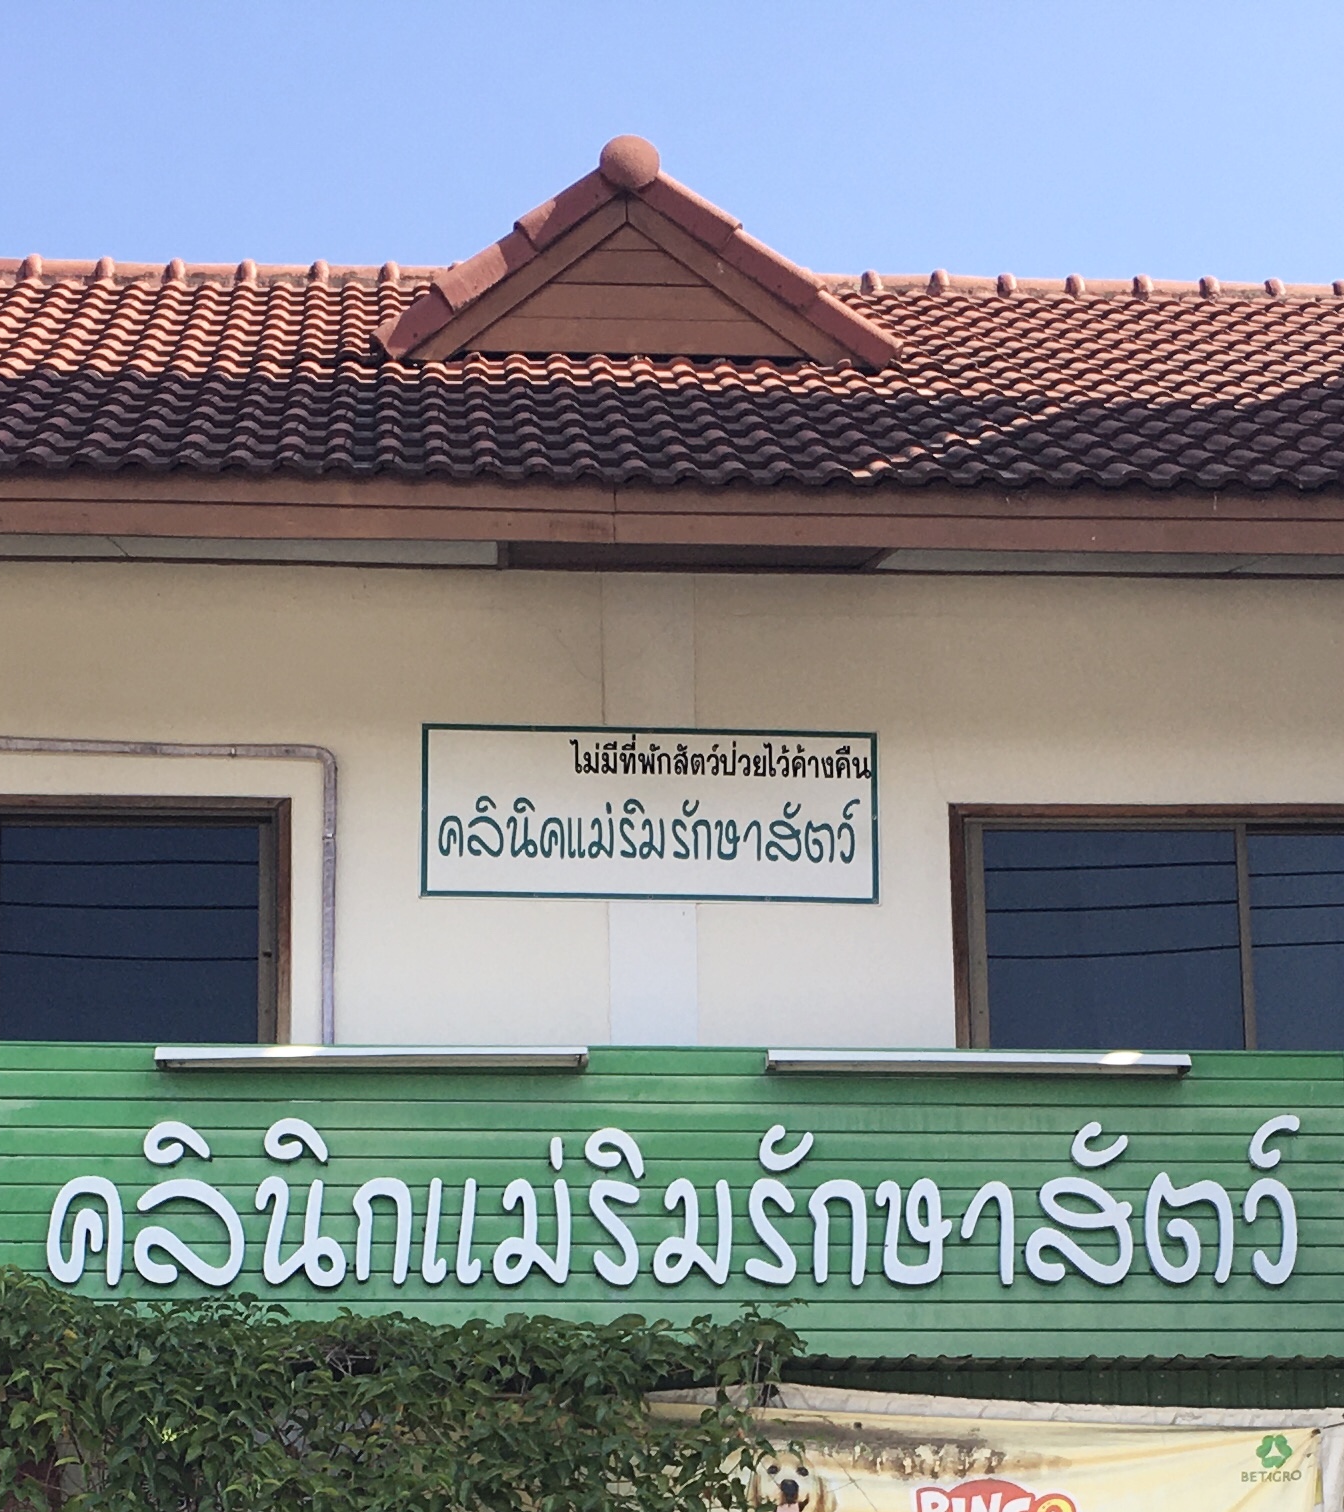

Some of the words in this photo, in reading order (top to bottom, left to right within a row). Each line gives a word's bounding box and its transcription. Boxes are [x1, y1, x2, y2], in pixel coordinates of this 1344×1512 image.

[569, 734, 872, 780] ไม่มีที่พักสัตว์ป่วยไว้ค้างคืน
[44, 1114, 1301, 1288] คลินิกแม่ริมรักษาสัตว์
[1241, 1469, 1302, 1483] BETAGRO
